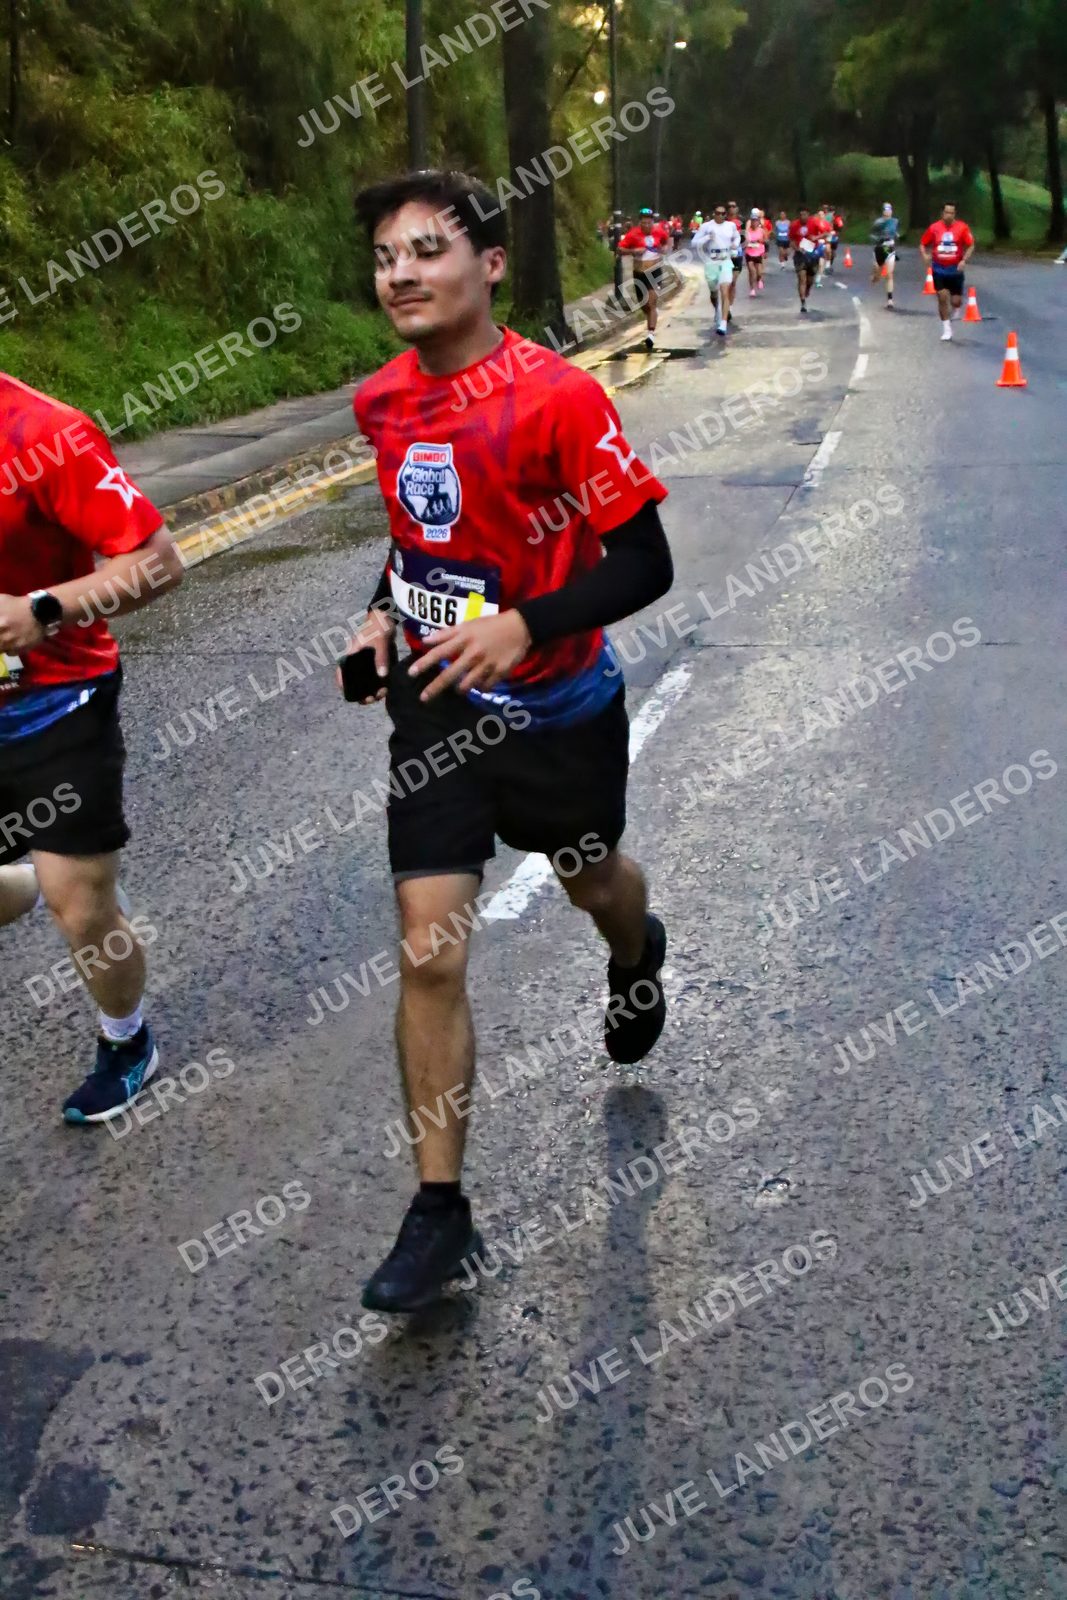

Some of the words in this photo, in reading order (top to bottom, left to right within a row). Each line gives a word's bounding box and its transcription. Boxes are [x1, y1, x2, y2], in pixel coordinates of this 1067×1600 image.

[413, 452, 446, 463] BIMBO
[411, 468, 446, 483] Global
[405, 481, 434, 495] Race
[426, 528, 448, 538] 2026
[408, 588, 457, 626] 4866
